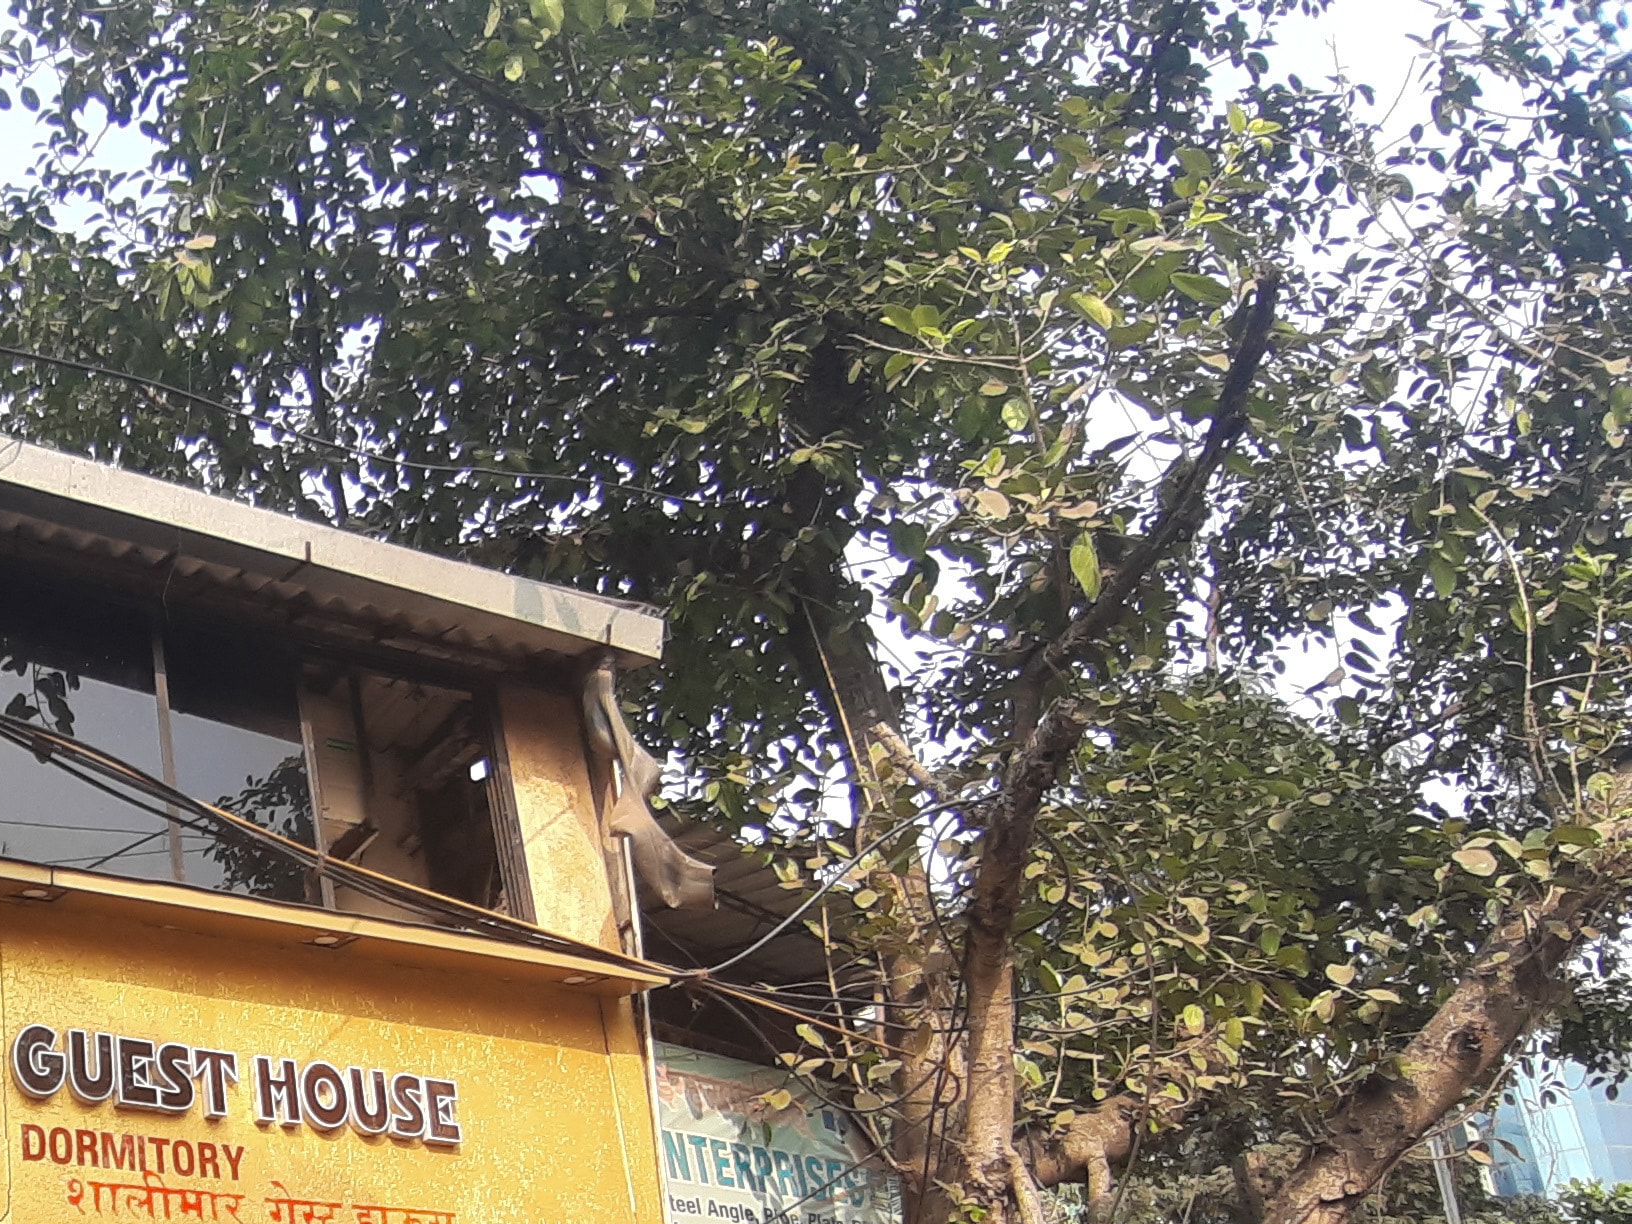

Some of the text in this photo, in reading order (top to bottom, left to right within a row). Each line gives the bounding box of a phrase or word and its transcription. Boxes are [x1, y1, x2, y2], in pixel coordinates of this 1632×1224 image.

[11, 1022, 238, 1121] GUEST
[251, 1054, 463, 1146] HOUSE
[21, 1123, 244, 1182] DORMITORY
[663, 1130, 867, 1208] NTERPRISES
[669, 1194, 701, 1216] teel
